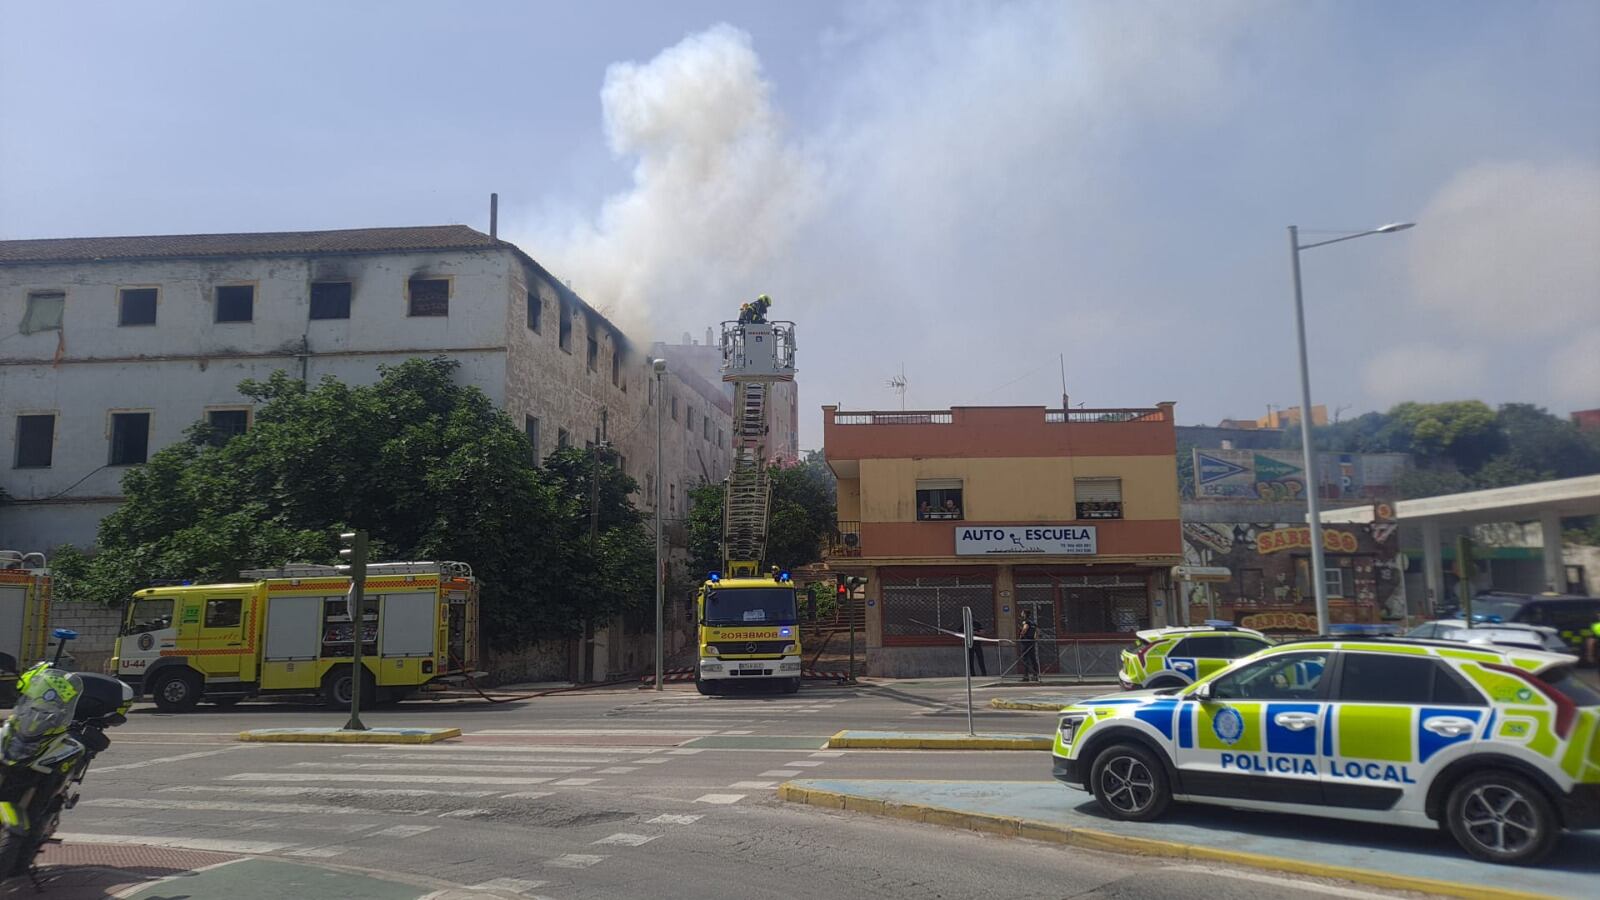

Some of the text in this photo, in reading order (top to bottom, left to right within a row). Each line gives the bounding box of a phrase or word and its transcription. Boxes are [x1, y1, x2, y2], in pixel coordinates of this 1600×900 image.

[962, 529, 1091, 541] AUTO ESCUELA
[1257, 528, 1357, 554] SABRSO
[122, 659, 145, 668] U-44
[1221, 752, 1417, 784] POLICIA LOCAL
